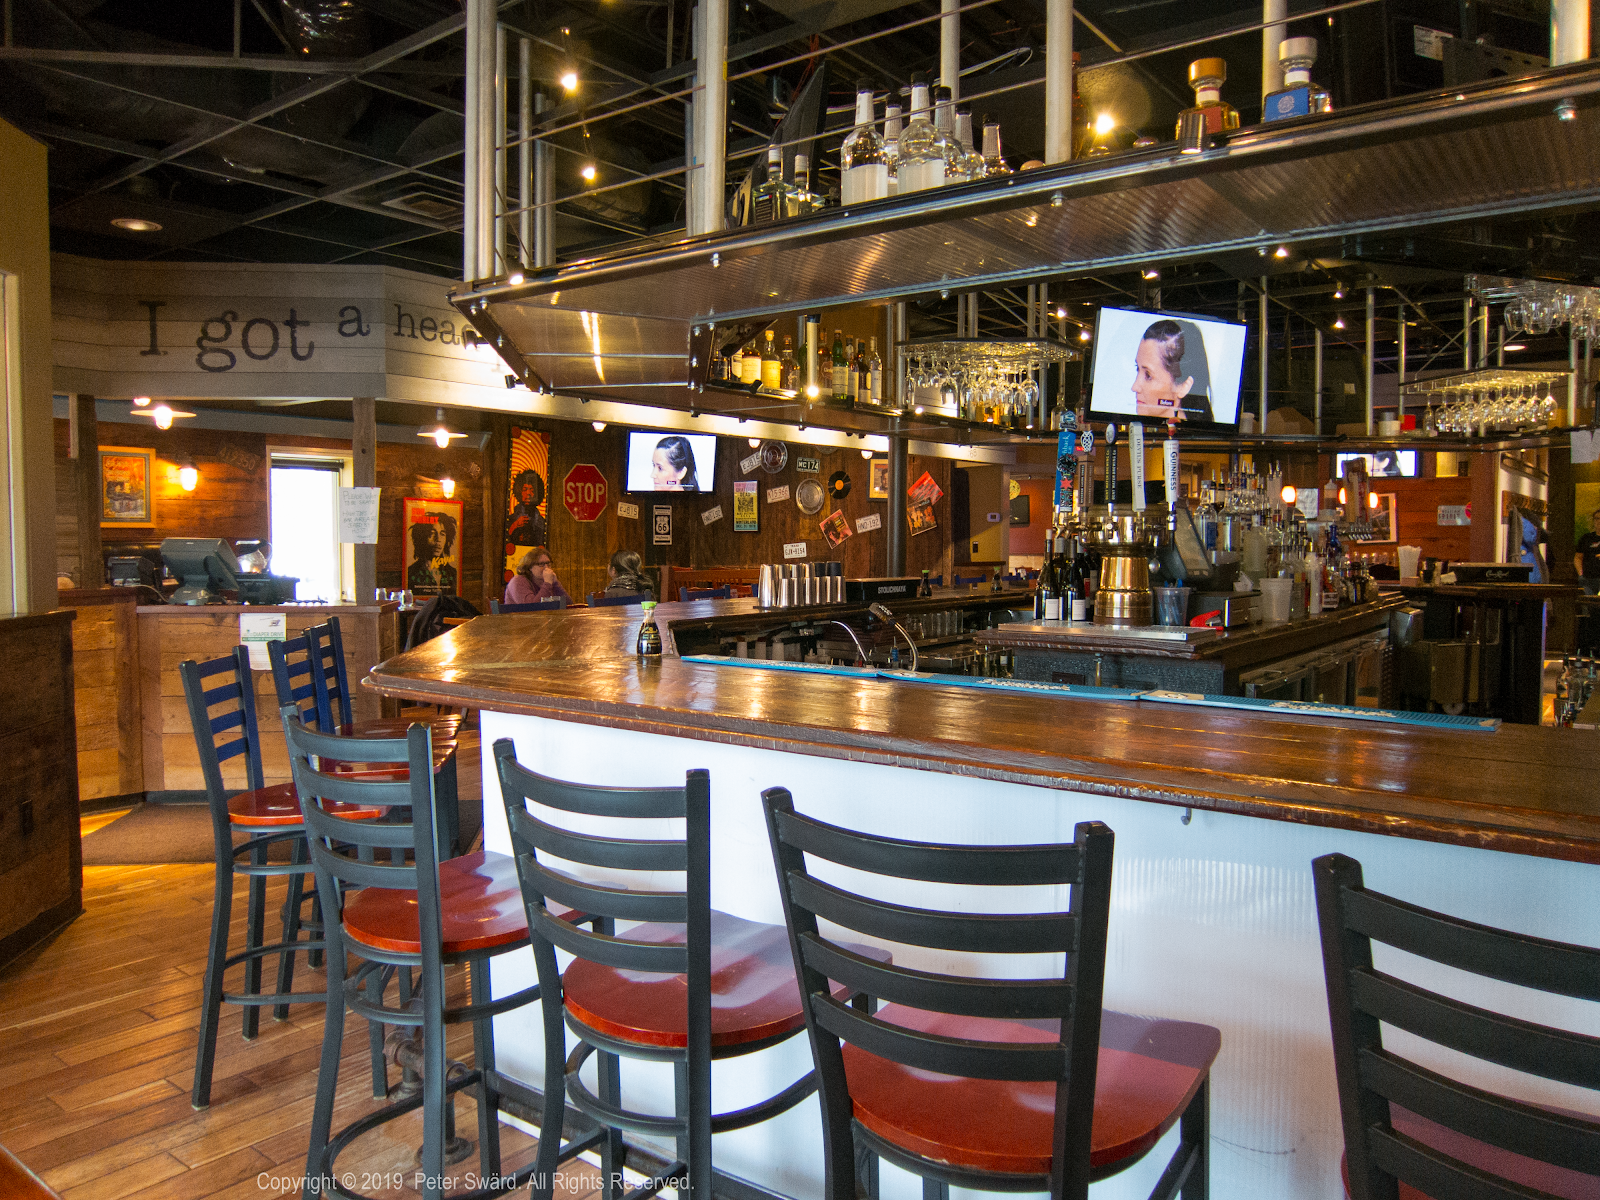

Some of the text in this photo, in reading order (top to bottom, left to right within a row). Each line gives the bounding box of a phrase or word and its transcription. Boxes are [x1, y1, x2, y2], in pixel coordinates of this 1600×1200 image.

[138, 300, 168, 356] I
[195, 307, 315, 373] got
[337, 305, 371, 338] a
[1170, 451, 1178, 491] GUINNESS
[566, 481, 605, 504] STOP
[657, 522, 667, 532] 66
[430, 554, 455, 570] Kaya
